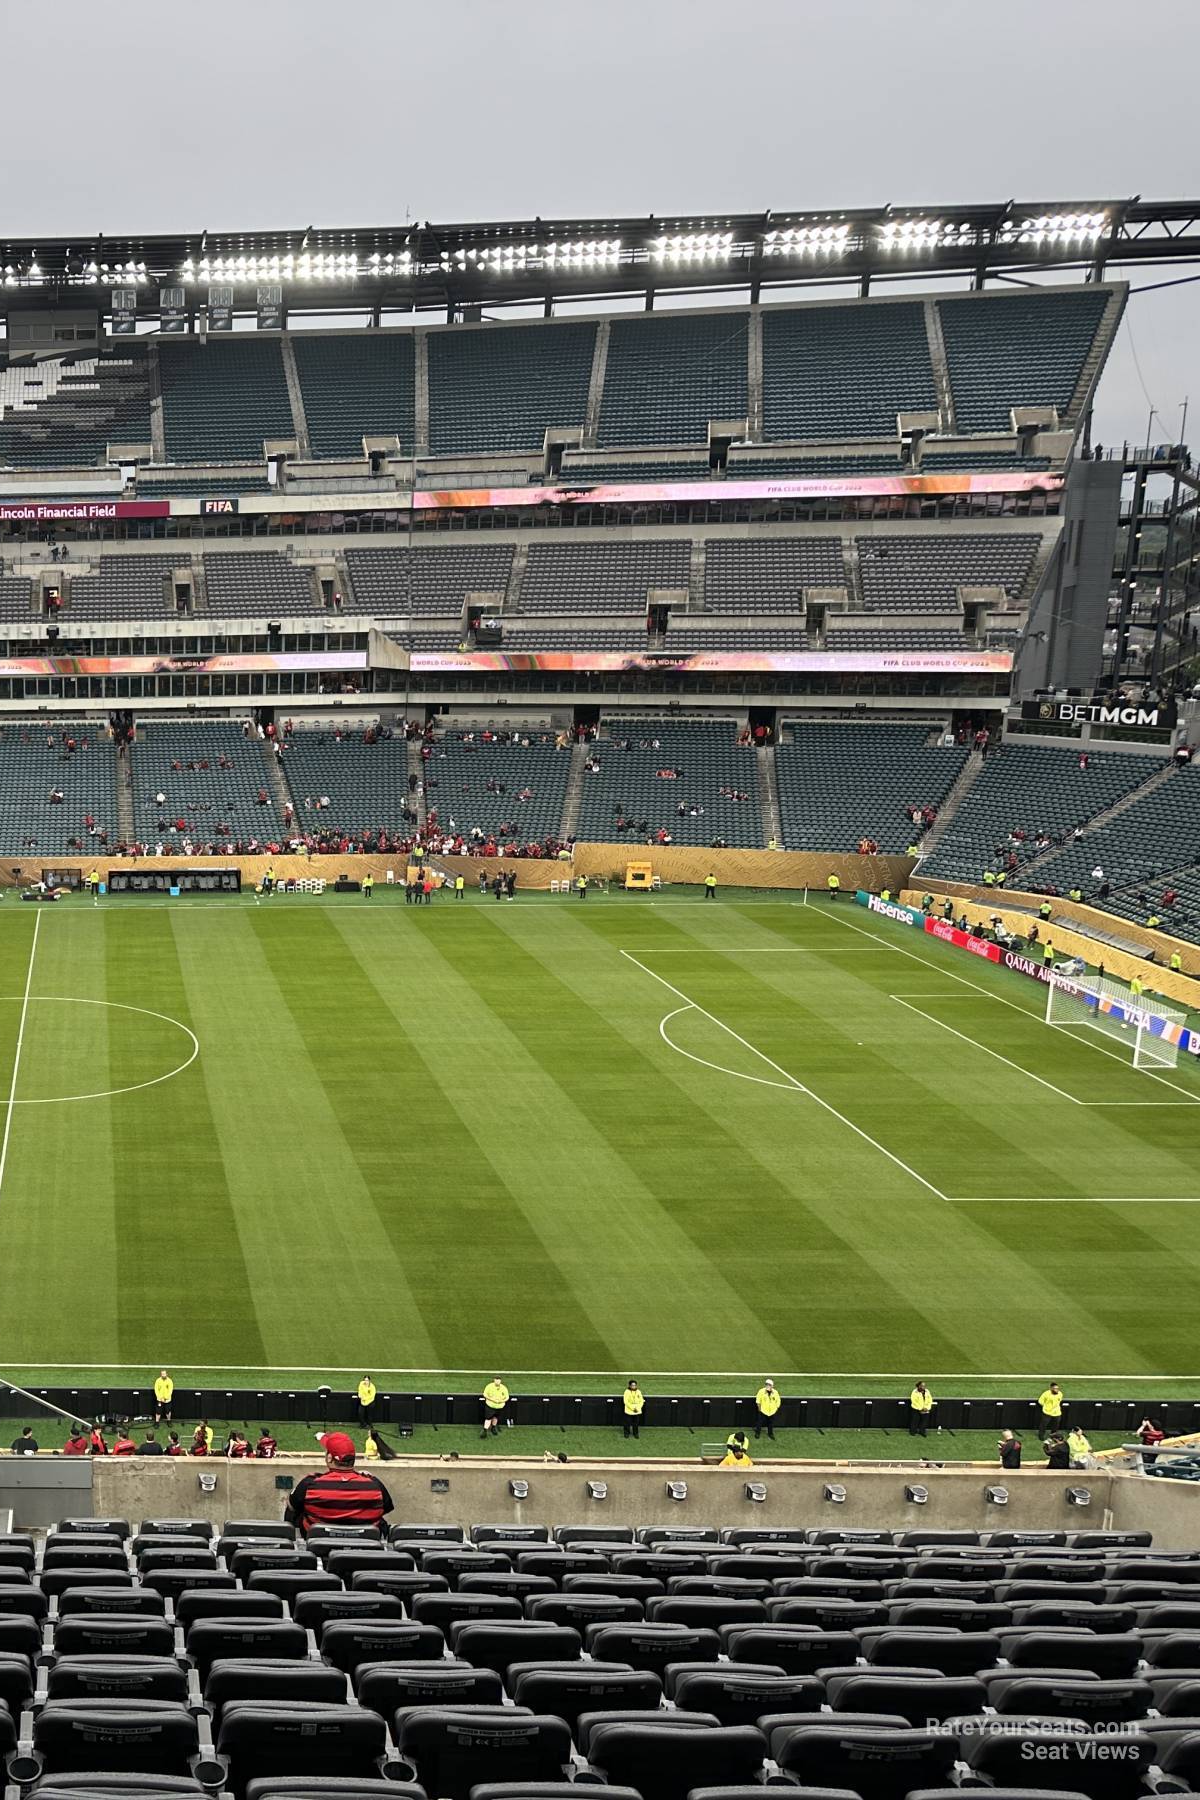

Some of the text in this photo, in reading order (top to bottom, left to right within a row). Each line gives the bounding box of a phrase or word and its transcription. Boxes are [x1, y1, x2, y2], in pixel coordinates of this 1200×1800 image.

[37, 505, 87, 518] Financial
[89, 504, 116, 517] Field
[205, 501, 233, 513] FIFA
[1058, 704, 1159, 726] BETMGM
[868, 895, 914, 925] Hisense
[1005, 952, 1036, 976] QATAR
